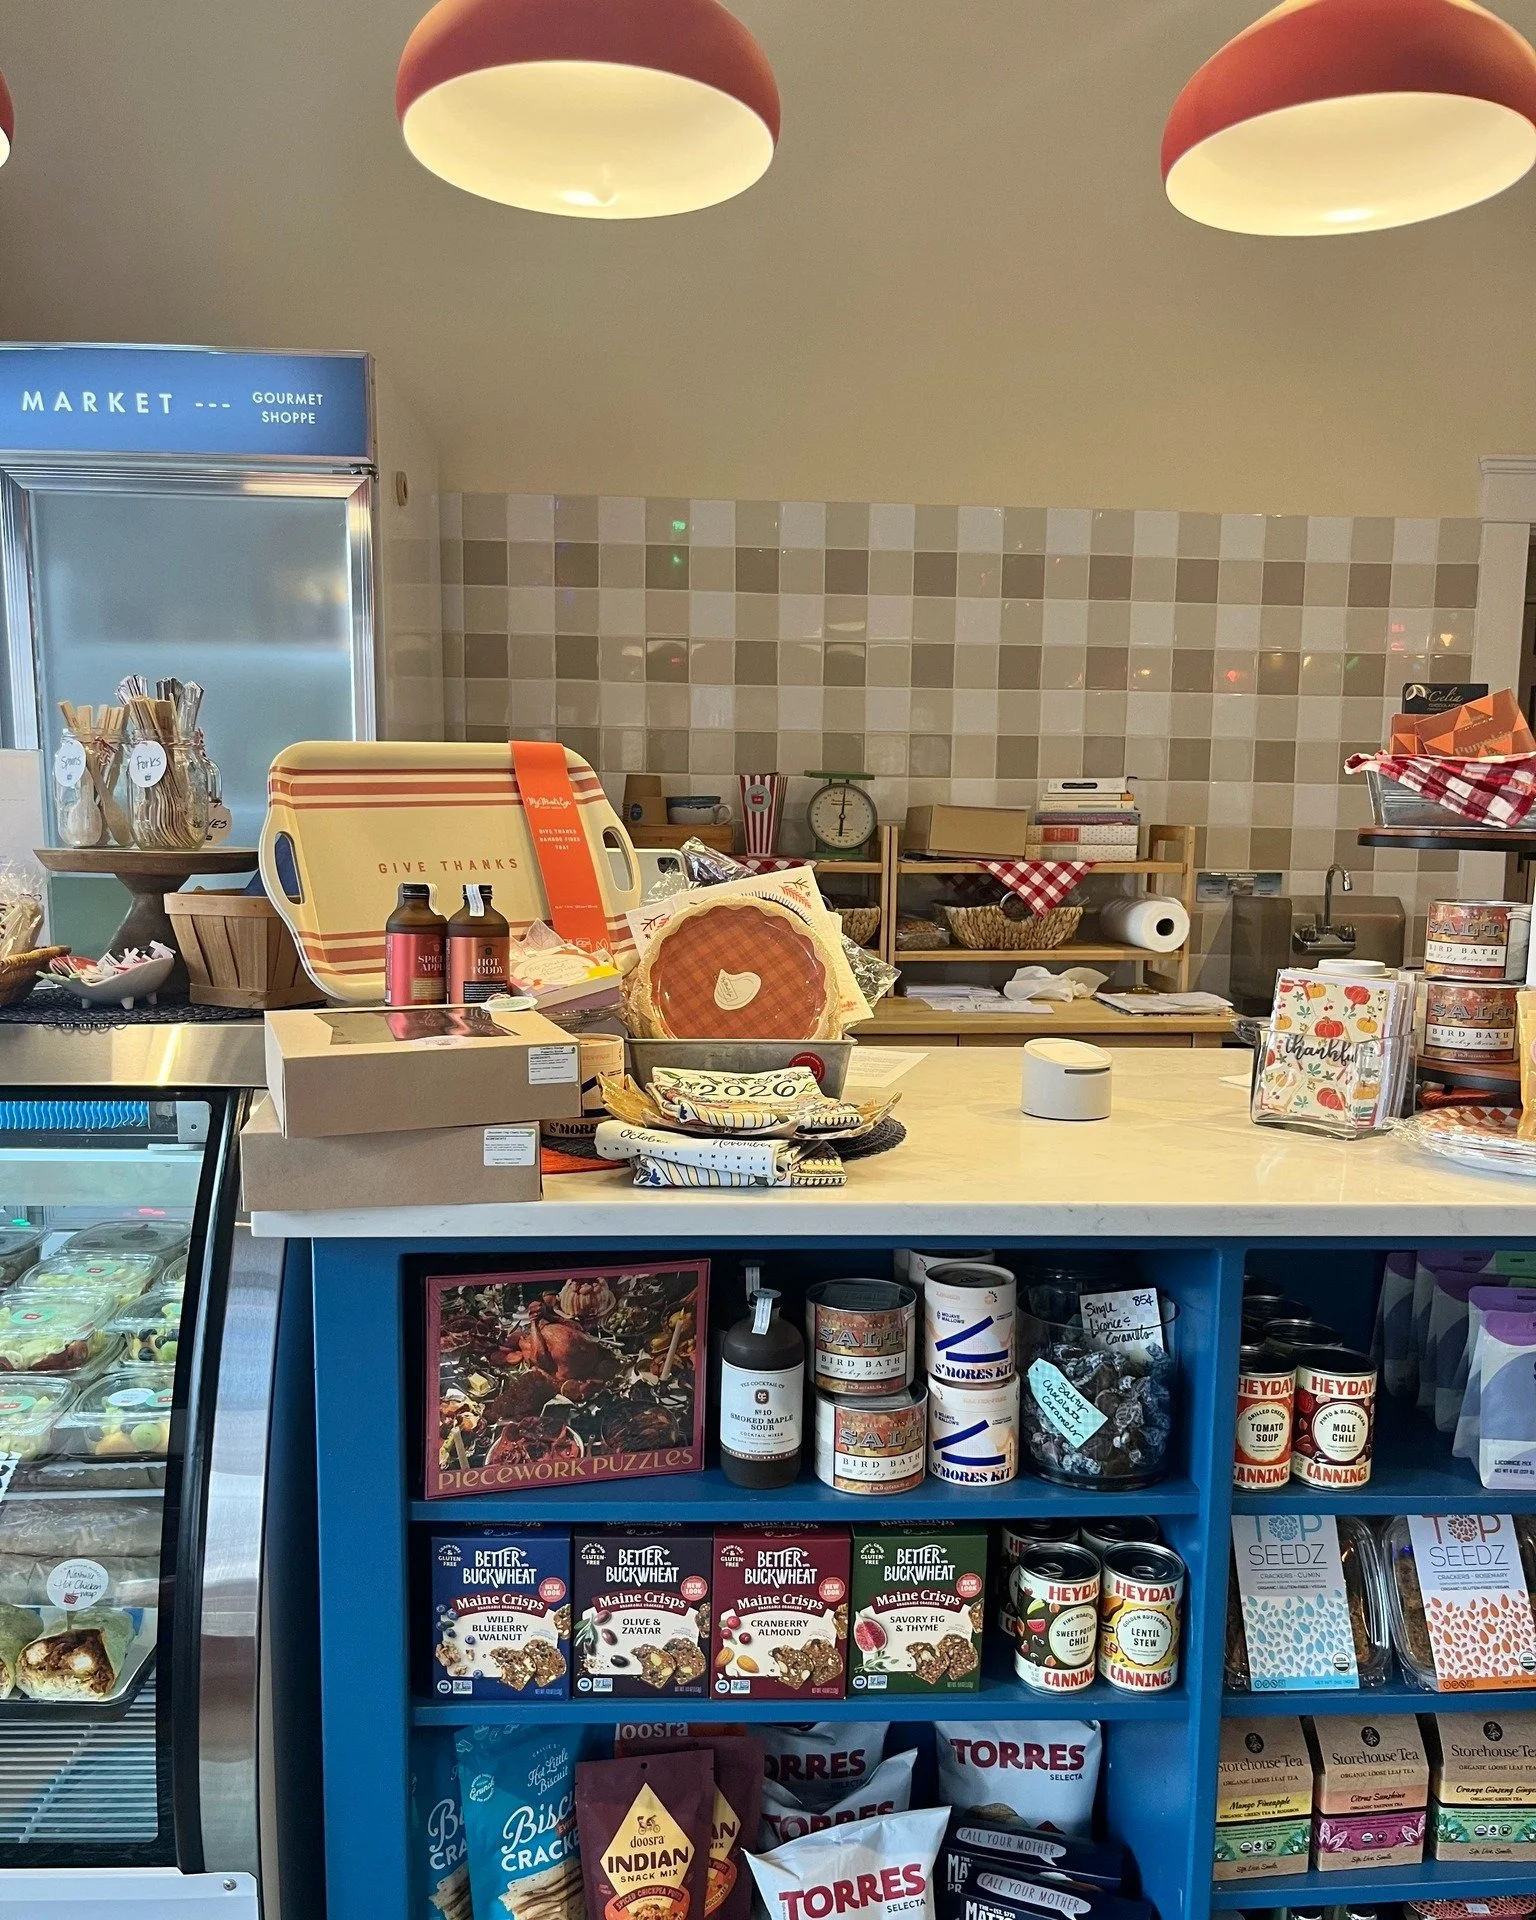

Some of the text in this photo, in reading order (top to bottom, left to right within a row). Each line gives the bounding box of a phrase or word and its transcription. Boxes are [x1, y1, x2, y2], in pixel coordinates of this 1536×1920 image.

[21, 390, 173, 415] MARKET
[252, 391, 323, 406] GOURMET
[261, 410, 316, 425] SHOPPE
[1428, 686, 1464, 702] Celia
[378, 858, 520, 875] GIVE THANKS
[1430, 919, 1503, 936] SALT
[472, 966, 503, 974] TODDY
[478, 958, 499, 966] HOT
[1432, 1001, 1513, 1020] SALT
[1432, 1028, 1466, 1037] BIRD
[1284, 1034, 1358, 1067] thankful
[699, 1079, 797, 1097] 2026
[713, 1139, 773, 1148] November
[1085, 1302, 1117, 1318] Single
[820, 1326, 904, 1347] SALT
[821, 1355, 900, 1368] BIRD BATH
[935, 1362, 1013, 1379] S'MORES KIT
[1312, 1376, 1373, 1395] HEYDAY
[731, 1413, 793, 1424] SMOKED MAPLE
[1248, 1409, 1269, 1421] GRILLED
[1251, 1423, 1283, 1432] TOMATO
[1333, 1424, 1356, 1432] MOLE
[840, 1428, 922, 1448] SALT
[1256, 1434, 1278, 1442] SOUP
[1332, 1434, 1355, 1442] CHILI
[843, 1453, 920, 1468] BIRD BATH
[933, 1462, 1011, 1482] S'MORES KIT
[475, 1549, 522, 1567] BETTER
[619, 1547, 664, 1565] BETTER
[758, 1549, 802, 1568] BETTER
[897, 1546, 942, 1564] BETTER
[1248, 1543, 1327, 1566] SEEDZ
[1429, 1544, 1509, 1567] SEEDZ
[463, 1568, 537, 1589] BUCKWHEAT
[606, 1566, 679, 1587] BUCKWHEAT
[745, 1568, 817, 1589] BUCKWHEAT
[884, 1565, 955, 1585] BUCKWHEAT
[876, 1590, 961, 1606] Maine Crisps
[1115, 1580, 1177, 1602] HEYDAY
[456, 1593, 544, 1610] Maine Crisps
[598, 1592, 686, 1609] Maine Crisps
[737, 1594, 824, 1610] Maine Crisps
[653, 1618, 661, 1626] &
[750, 1620, 809, 1628] CRANBERRY
[890, 1615, 945, 1624] SAVORY FIG
[621, 1627, 661, 1635] ZA'ATAR
[758, 1629, 801, 1637] ALMOND
[906, 1624, 939, 1632] THYME
[1131, 1628, 1160, 1637] LENTIL
[479, 1633, 523, 1641] WALNUT
[1069, 1635, 1088, 1646] CHILI
[1134, 1638, 1157, 1647] STEW
[950, 1739, 1086, 1771] TORRES
[1280, 1754, 1304, 1767] Tea
[1332, 1748, 1419, 1765] Storehouse Tea
[527, 1747, 568, 1788] Hot Little
[538, 1765, 568, 1796] Biscuit
[1050, 1773, 1083, 1781] SELECTA
[1350, 1791, 1406, 1803] Citrus Sunshine
[1456, 1786, 1483, 1795] Orange
[1485, 1786, 1513, 1796] Ginseng
[1230, 1797, 1291, 1811] Mango Pineapple
[630, 1835, 665, 1848] doosra
[960, 1830, 1059, 1856] CALL YOUR MOTHER.
[607, 1846, 689, 1874] INDIAN
[620, 1868, 679, 1883] SNACK MIX
[616, 1892, 636, 1910] SPICED
[638, 1887, 666, 1898] CHICKPEA
[778, 1863, 926, 1920] TORRES
[981, 1874, 1082, 1912] CALL YOUR MOTHER.
[887, 1898, 926, 1914] SELECTA
